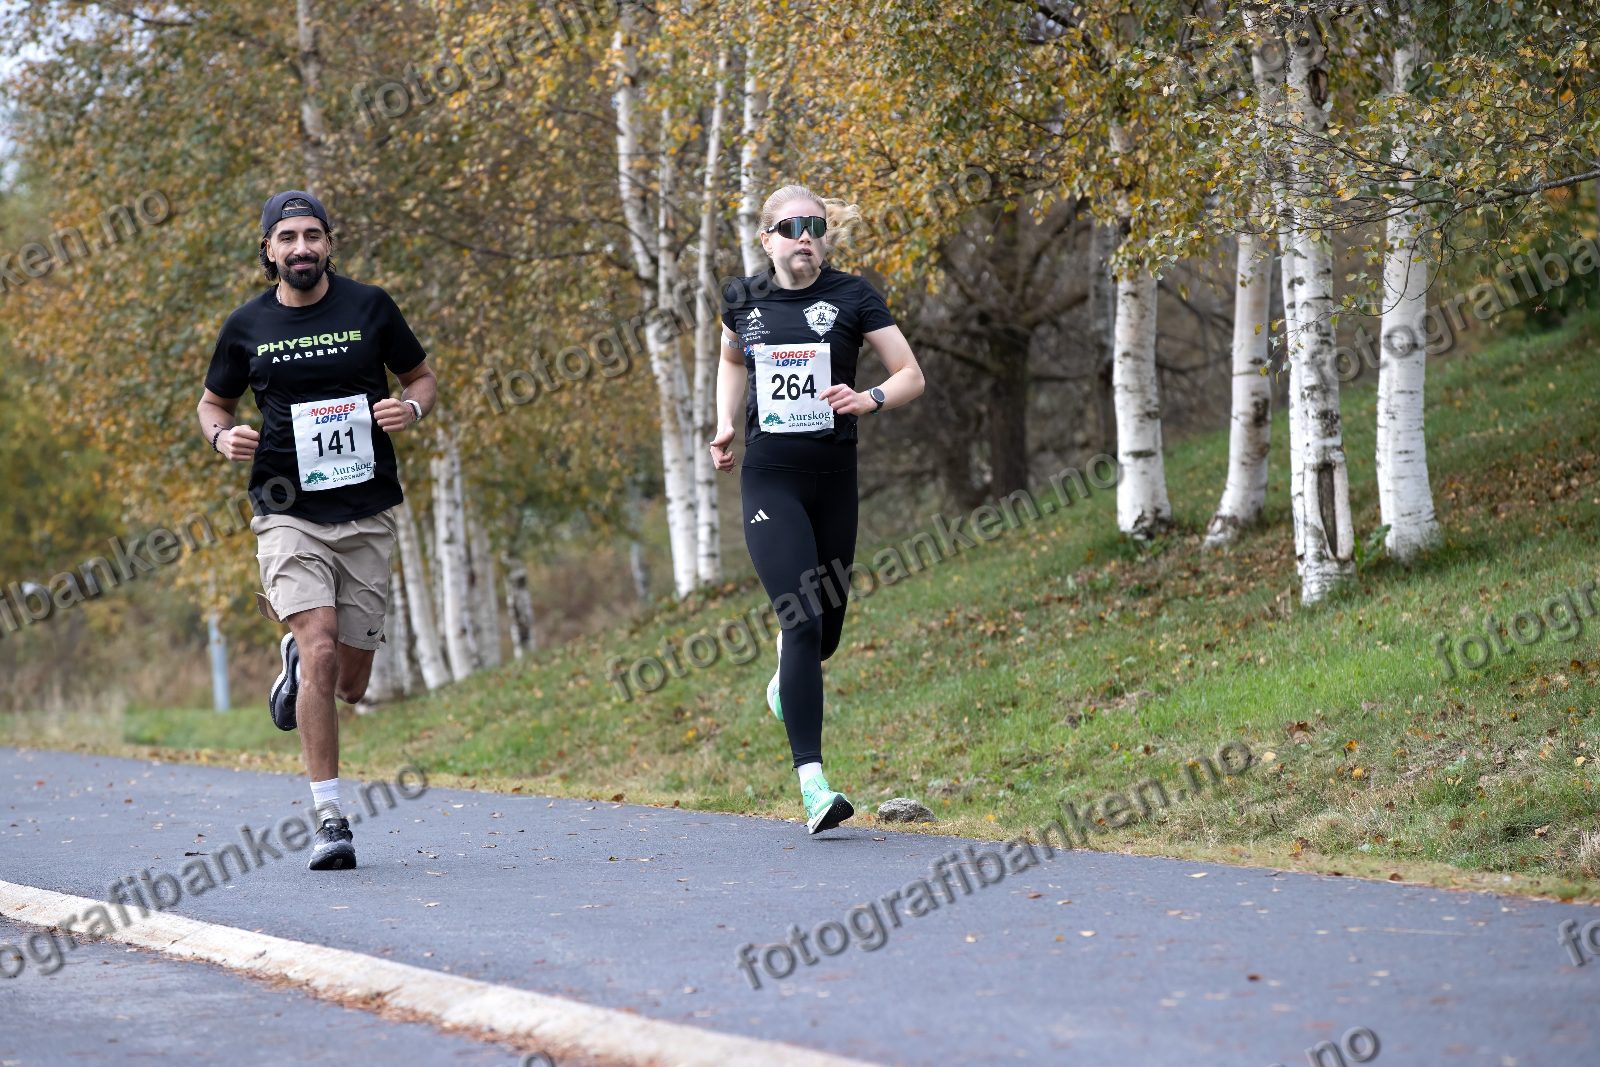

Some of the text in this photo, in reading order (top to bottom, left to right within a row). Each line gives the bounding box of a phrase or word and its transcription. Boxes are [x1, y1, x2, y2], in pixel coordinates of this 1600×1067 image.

[256, 330, 362, 357] PHYSIQUE
[271, 346, 349, 364] ACADEMY
[771, 350, 817, 360] NORGES
[775, 358, 810, 367] LØPET
[771, 373, 817, 401] 264
[310, 402, 356, 417] NORGES
[787, 410, 831, 423] Aurskog
[315, 412, 350, 425] LØPET
[311, 426, 356, 458] 141
[332, 461, 373, 476] Aurskog
